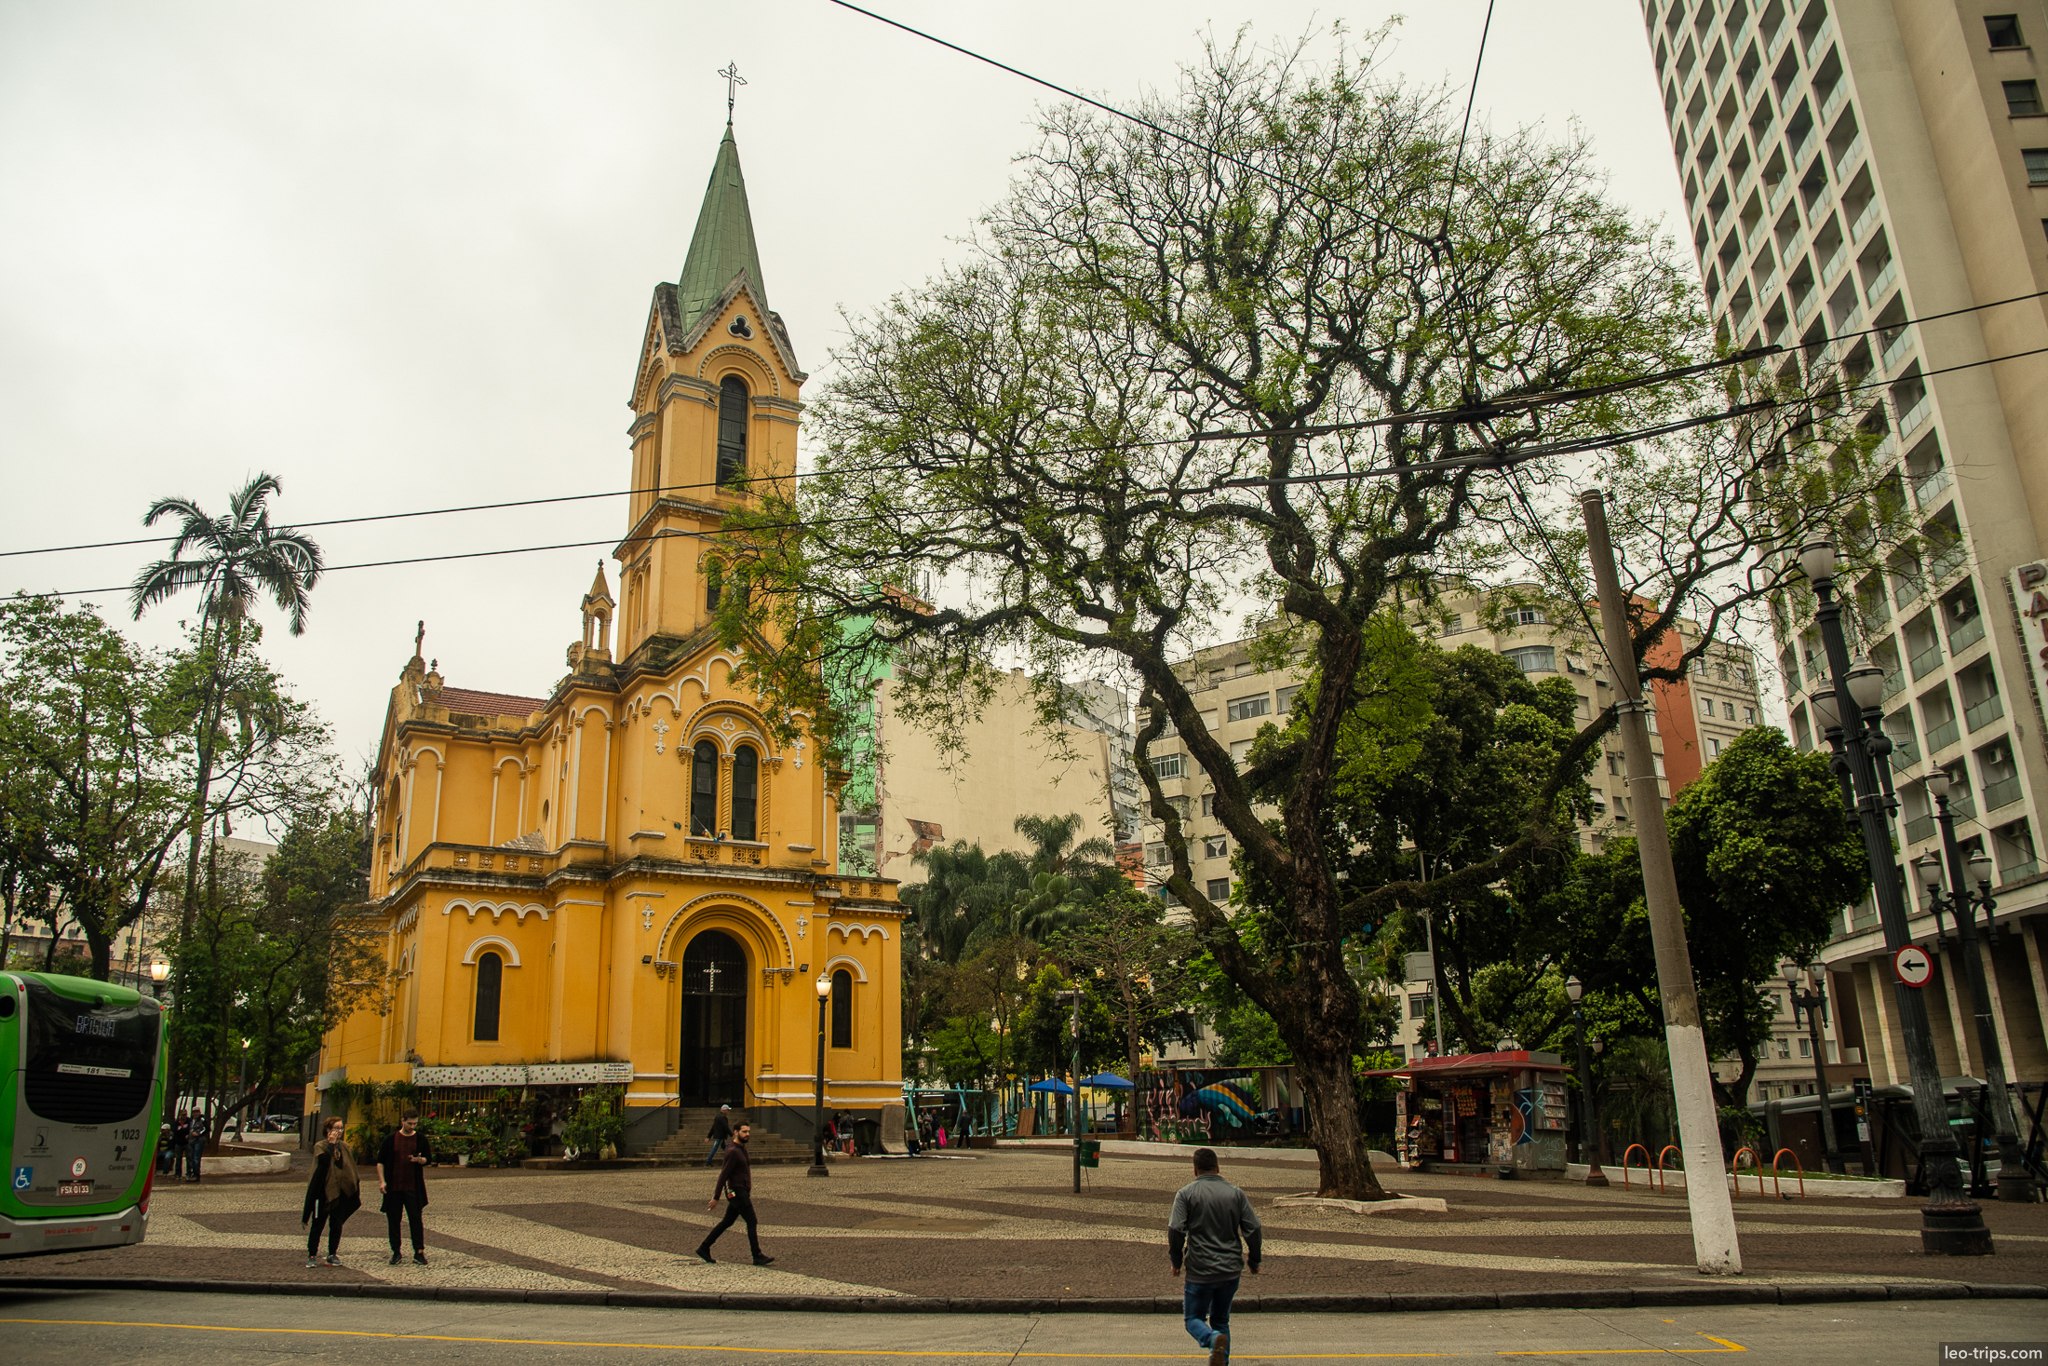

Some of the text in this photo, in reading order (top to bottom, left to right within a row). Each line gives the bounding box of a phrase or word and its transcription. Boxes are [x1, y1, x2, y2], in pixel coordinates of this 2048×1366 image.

[86, 1067, 100, 1075] 181
[113, 1129, 140, 1140] 1 1023
